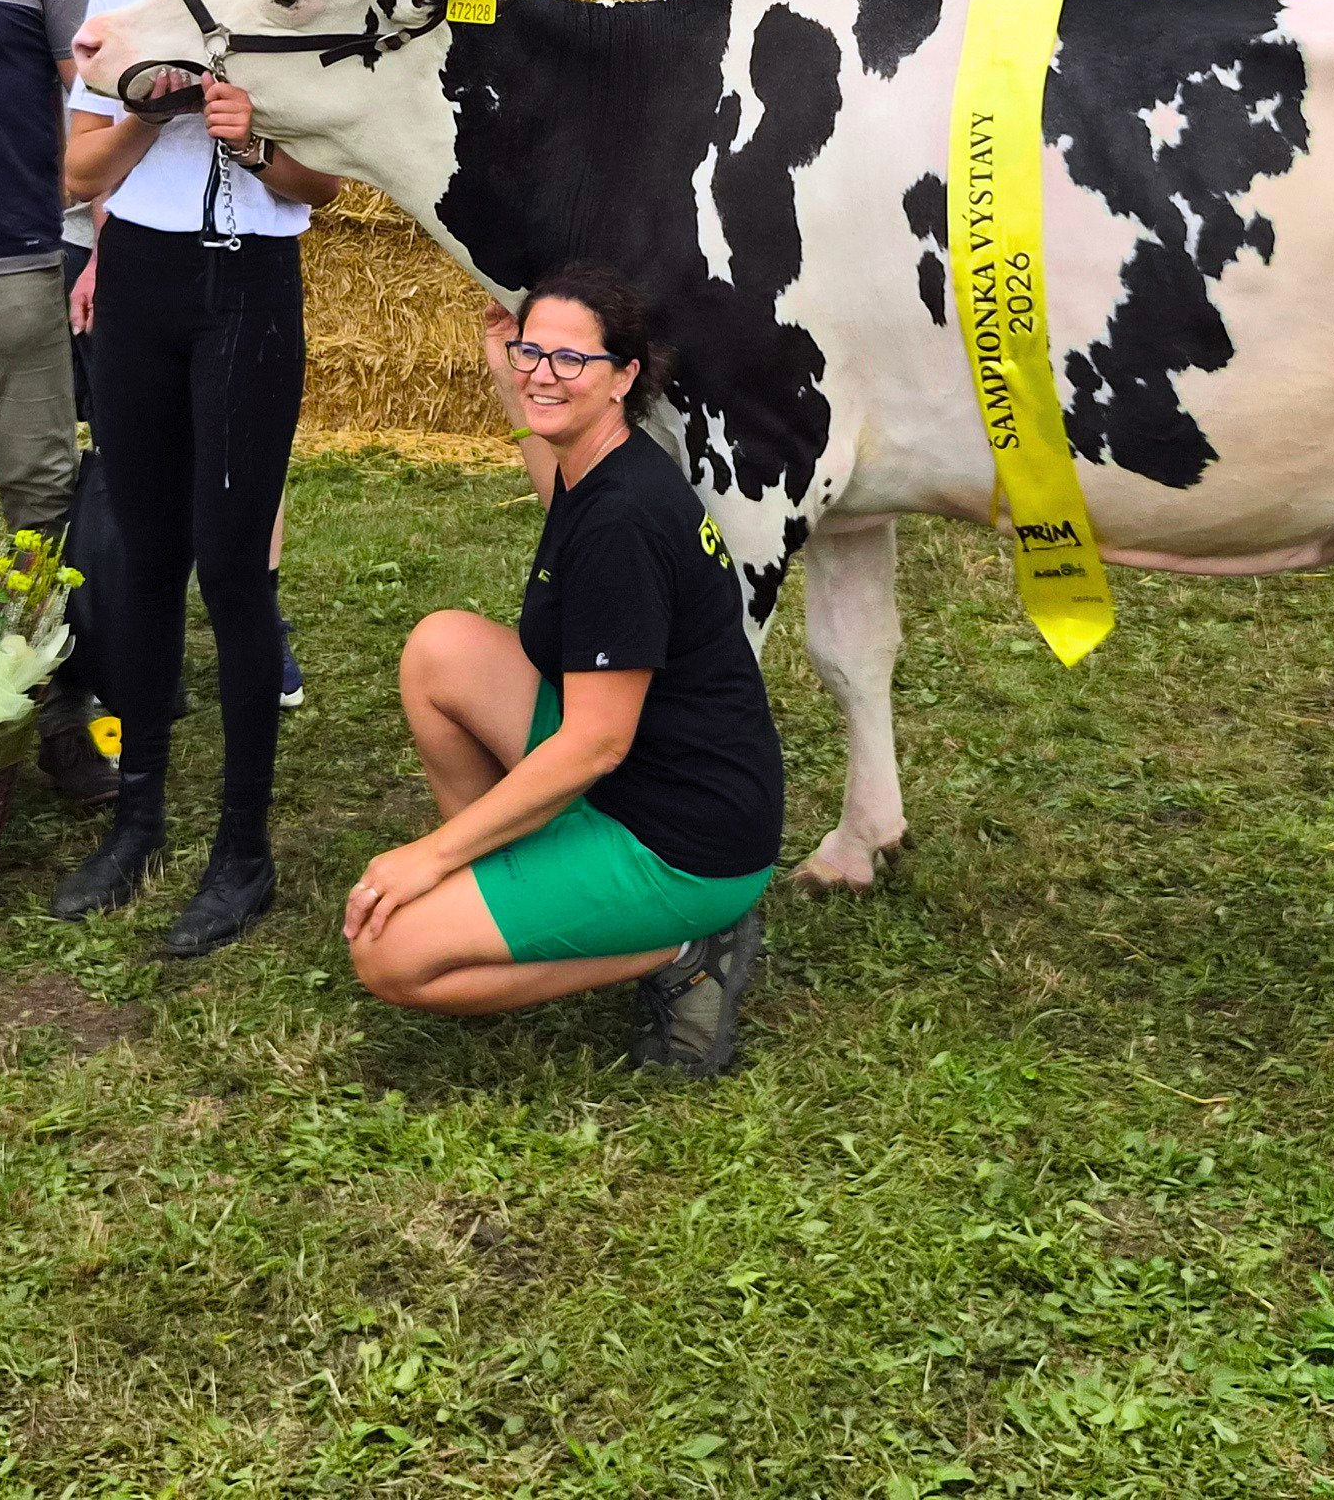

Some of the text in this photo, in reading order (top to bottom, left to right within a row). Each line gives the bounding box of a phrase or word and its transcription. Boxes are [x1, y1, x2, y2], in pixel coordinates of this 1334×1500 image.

[449, 1, 491, 22] 472128
[961, 112, 1020, 450] ŠAMPIONKA VÝSTAVY
[1004, 251, 1034, 334] 2026
